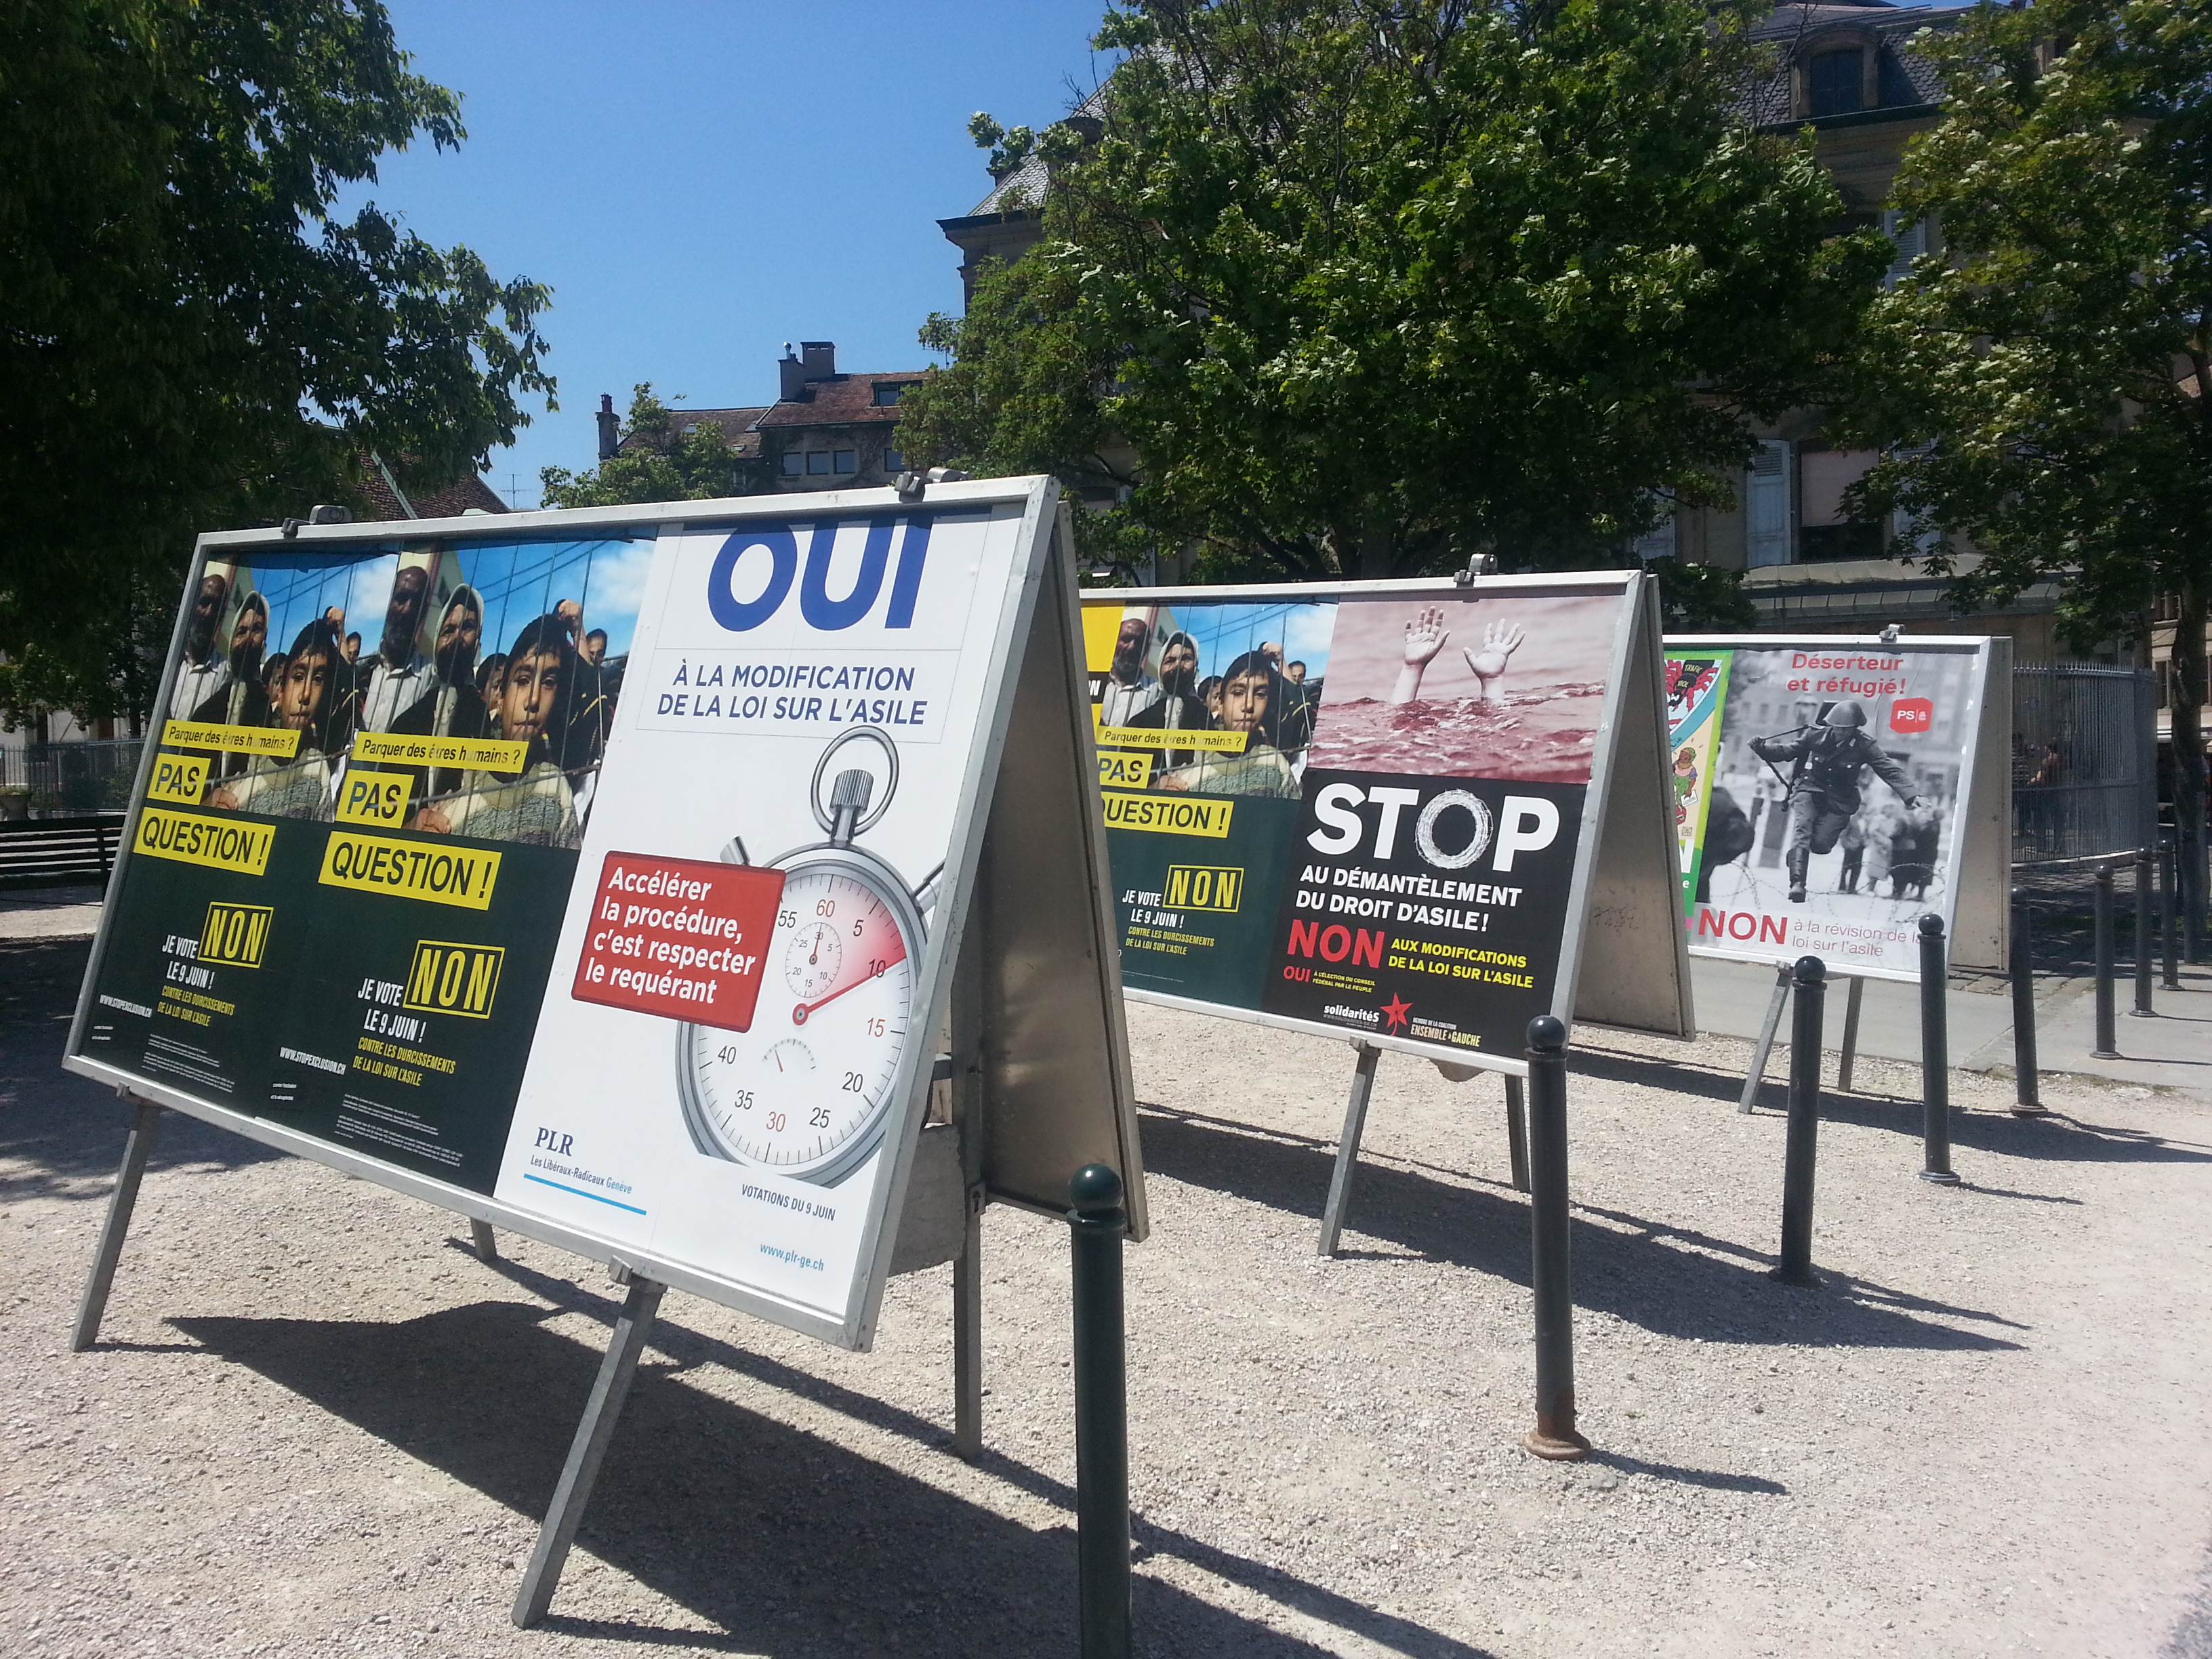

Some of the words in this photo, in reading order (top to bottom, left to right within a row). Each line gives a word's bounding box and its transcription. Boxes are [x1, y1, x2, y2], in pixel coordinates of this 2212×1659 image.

[708, 518, 934, 632] OUI
[672, 658, 688, 687] À
[695, 665, 724, 687] LA
[731, 665, 916, 691] MODIFICATION
[1791, 653, 1904, 671] Déserteur
[1787, 678, 1810, 692] et
[1816, 676, 1906, 698] réfugié!
[657, 693, 689, 716] DE
[693, 695, 721, 717] LA
[729, 695, 769, 719] LOI
[773, 697, 822, 721] SUR
[829, 698, 928, 725] L'ASILE
[1897, 710, 1914, 720] PS
[169, 726, 205, 743] Parquer
[205, 731, 220, 743] des
[363, 739, 405, 758] Parquer
[407, 743, 426, 758] des
[1105, 731, 1143, 743] Parquer
[1144, 733, 1161, 743] des
[155, 762, 200, 797] PAS
[1098, 758, 1143, 783] PAS
[346, 781, 401, 819] PAS
[142, 816, 255, 863] QUESTION
[1306, 782, 1560, 872] STOP
[332, 842, 474, 896] QUESTION
[607, 866, 712, 901] Accélérer
[1122, 889, 1136, 903] JE
[1137, 890, 1162, 907] VOTE
[1169, 870, 1237, 908] NON
[1299, 865, 1330, 884] AU
[1332, 866, 1523, 907] DÉMANTÈLEMENT
[778, 910, 798, 928] 55
[816, 899, 836, 918] 60
[1130, 908, 1144, 923] LE
[1144, 911, 1151, 924] 9
[1152, 912, 1178, 928] JUIN
[1295, 890, 1326, 909] DU
[1328, 894, 1393, 919] DROIT
[162, 935, 176, 954] JE
[176, 937, 199, 959] VOTE
[203, 909, 266, 962] NON
[600, 896, 620, 921] la
[623, 905, 743, 945] procédure,
[853, 919, 864, 937] 5
[1698, 908, 1788, 945] NON
[1794, 919, 1803, 931] à
[1807, 920, 1820, 933] la
[1825, 922, 1882, 940] révision
[1887, 929, 1906, 943] de
[594, 928, 644, 958] c'est
[647, 940, 756, 975] respecter
[1287, 919, 1386, 969] NON
[1391, 938, 1419, 953] AUX
[1421, 941, 1527, 968] MODIFICATIONS
[1792, 935, 1809, 948] loi
[1814, 939, 1838, 951] sur
[1841, 941, 1884, 957] l'asile
[166, 960, 180, 980] LE
[178, 964, 186, 982] 9
[185, 966, 209, 989] JUIN
[358, 978, 375, 1000] JE
[375, 981, 403, 1007] VOTE
[411, 949, 495, 1011] NON
[585, 956, 605, 983] le
[609, 966, 718, 1004] requérant
[868, 958, 886, 978] 10
[1283, 965, 1311, 982] OUI
[1388, 955, 1406, 969] DE
[1409, 958, 1425, 972] LA
[1427, 961, 1450, 976] LOI
[1452, 964, 1480, 980] SUR
[1483, 970, 1534, 989] L'ASILE
[363, 1008, 380, 1031] LE
[379, 1013, 388, 1033] 9
[388, 1015, 419, 1041] JUIN
[867, 1017, 886, 1038] 15
[1410, 1024, 1448, 1041] ENSEMBLE
[1451, 1031, 1481, 1047] GAUCHE
[358, 1037, 384, 1054] CONTRE
[384, 1044, 397, 1058] LES
[396, 1047, 456, 1074] DURCISSEMENTS
[717, 1045, 737, 1065] 40
[352, 1056, 363, 1069] DE
[363, 1058, 372, 1071] LA
[371, 1061, 384, 1075] LOI
[383, 1064, 398, 1079] SUR
[398, 1068, 422, 1086] L'ASILE
[842, 1071, 863, 1093] 20
[735, 1089, 754, 1111] 35
[766, 1111, 785, 1132] 30
[809, 1106, 831, 1129] 25
[534, 1126, 574, 1157] PLR
[530, 1154, 542, 1167] Les
[542, 1158, 605, 1186] Libéraux-Radicaux
[606, 1177, 632, 1194] Genève
[741, 1183, 790, 1208] VOTATIONS
[791, 1197, 805, 1212] DU
[805, 1202, 813, 1214] 9
[812, 1203, 836, 1221] JUIN
[760, 1243, 825, 1271] www.plr-ge.ch
